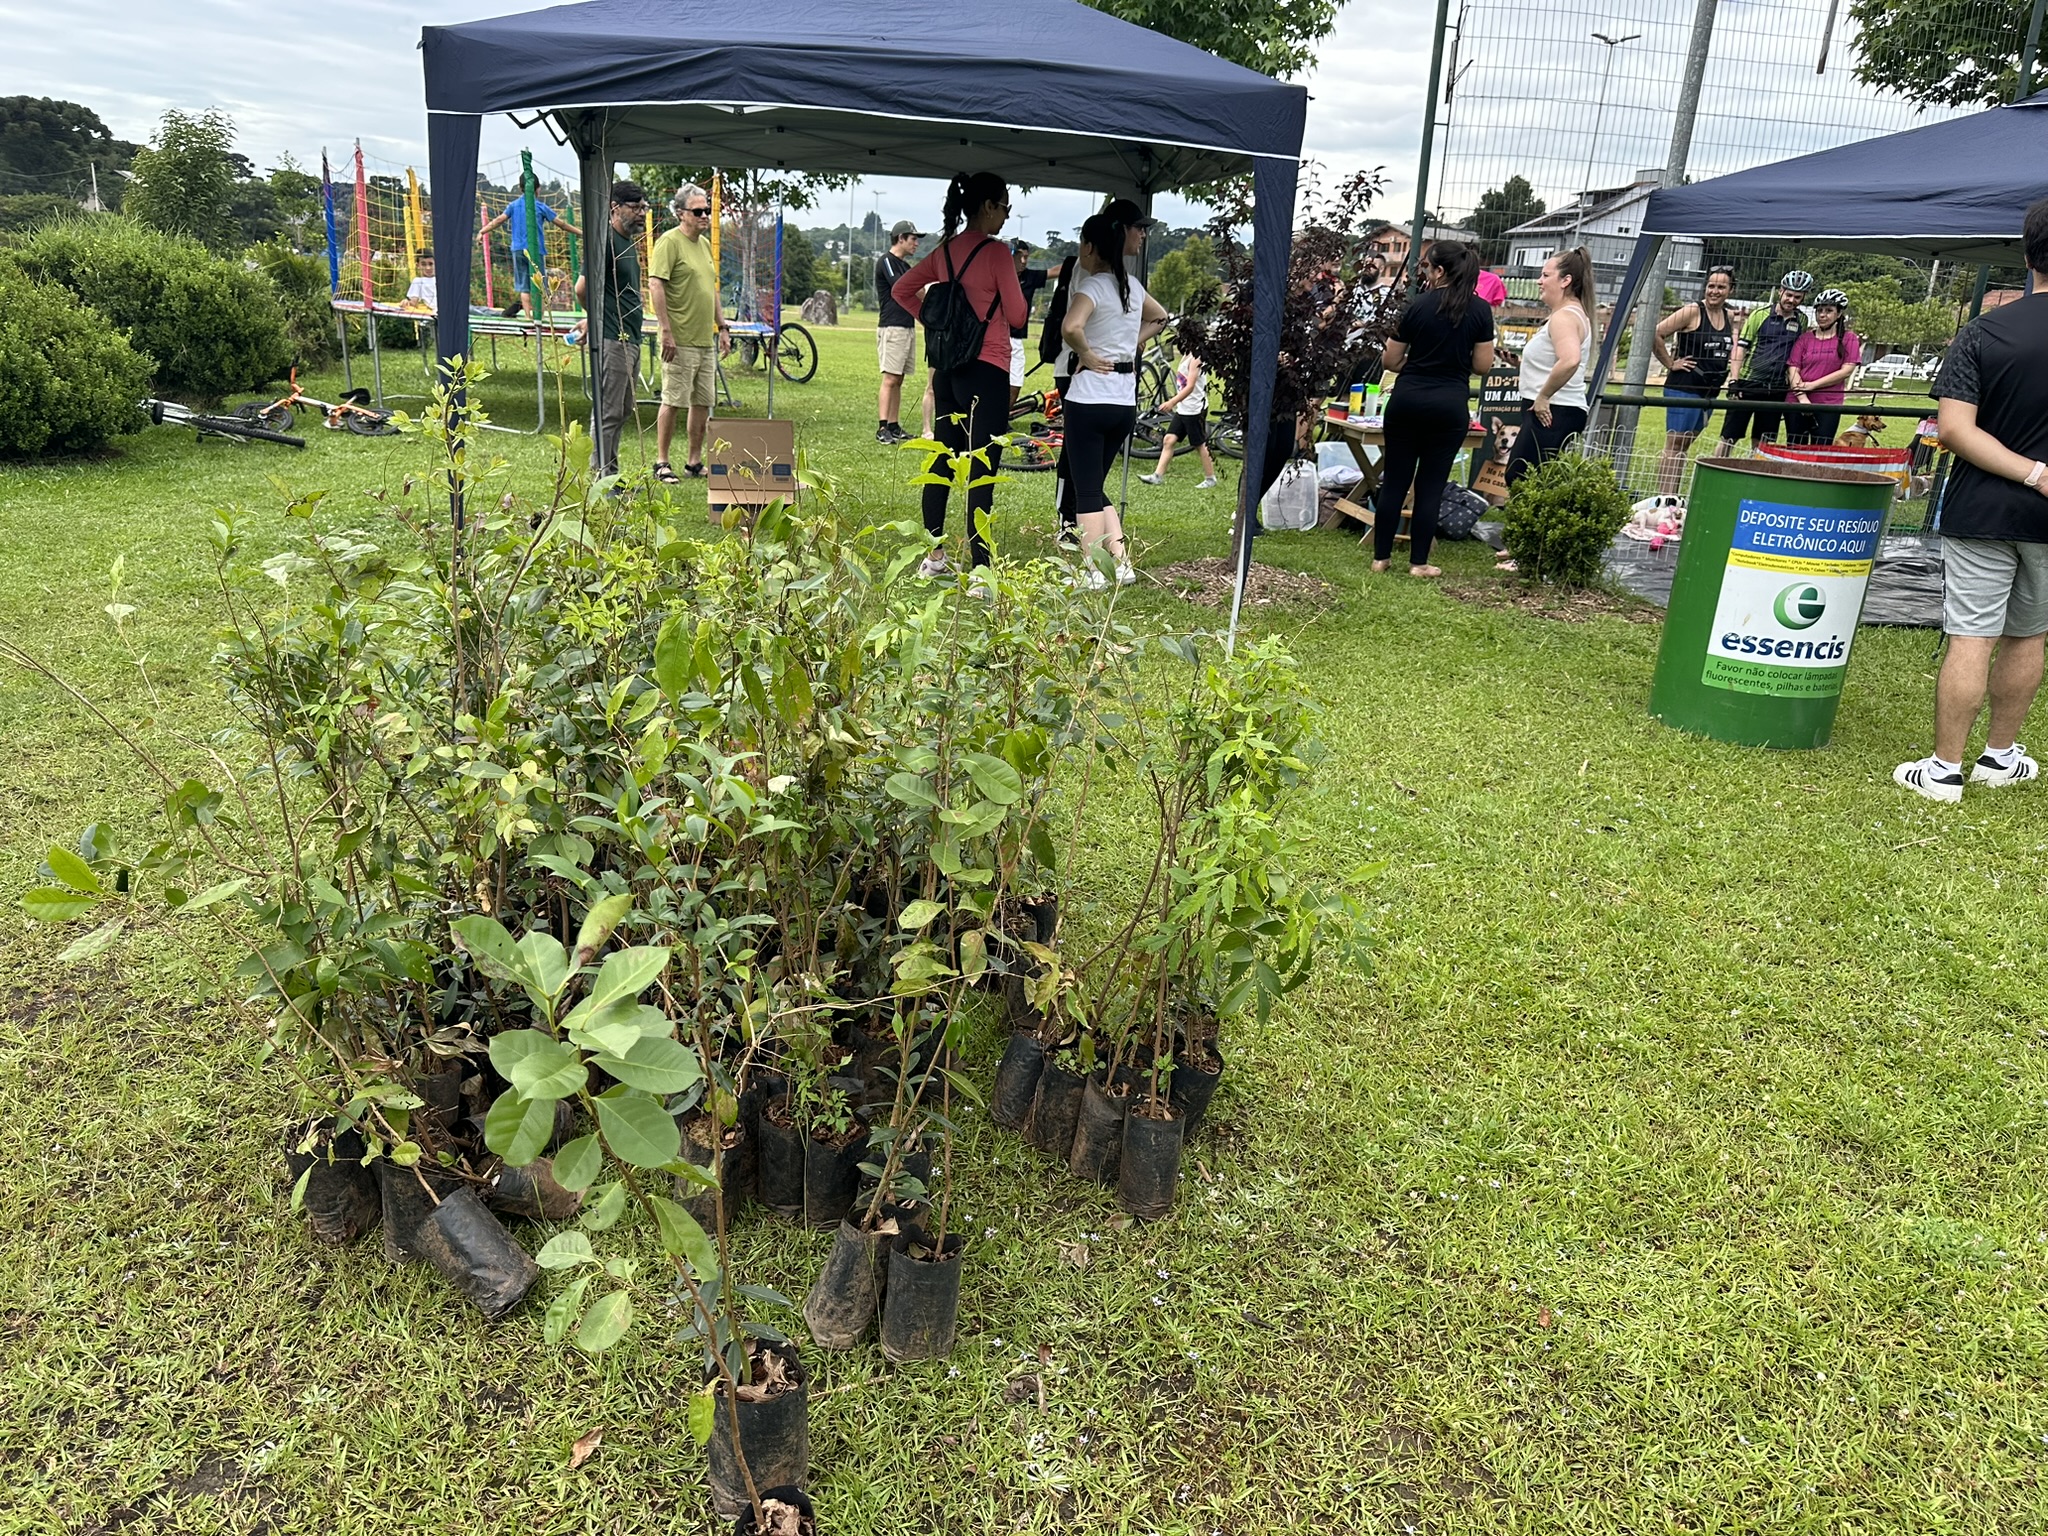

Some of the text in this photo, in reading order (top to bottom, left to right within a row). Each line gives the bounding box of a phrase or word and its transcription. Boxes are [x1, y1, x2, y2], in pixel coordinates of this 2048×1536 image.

[1484, 390, 1522, 402] UM AM
[1479, 476, 1491, 484] pra
[1486, 467, 1505, 478] Me le
[1740, 509, 1879, 534] DEPOSITE SEU RESÍDUO
[1752, 531, 1866, 554] ELETRÔNICO AQUI
[1721, 632, 1845, 660] essencis
[1705, 669, 1774, 690] fluorescentes,
[1776, 681, 1803, 692] pilhas
[1812, 682, 1838, 692] baterias
[1716, 661, 1838, 682] Favor não colocar lâmpadas
